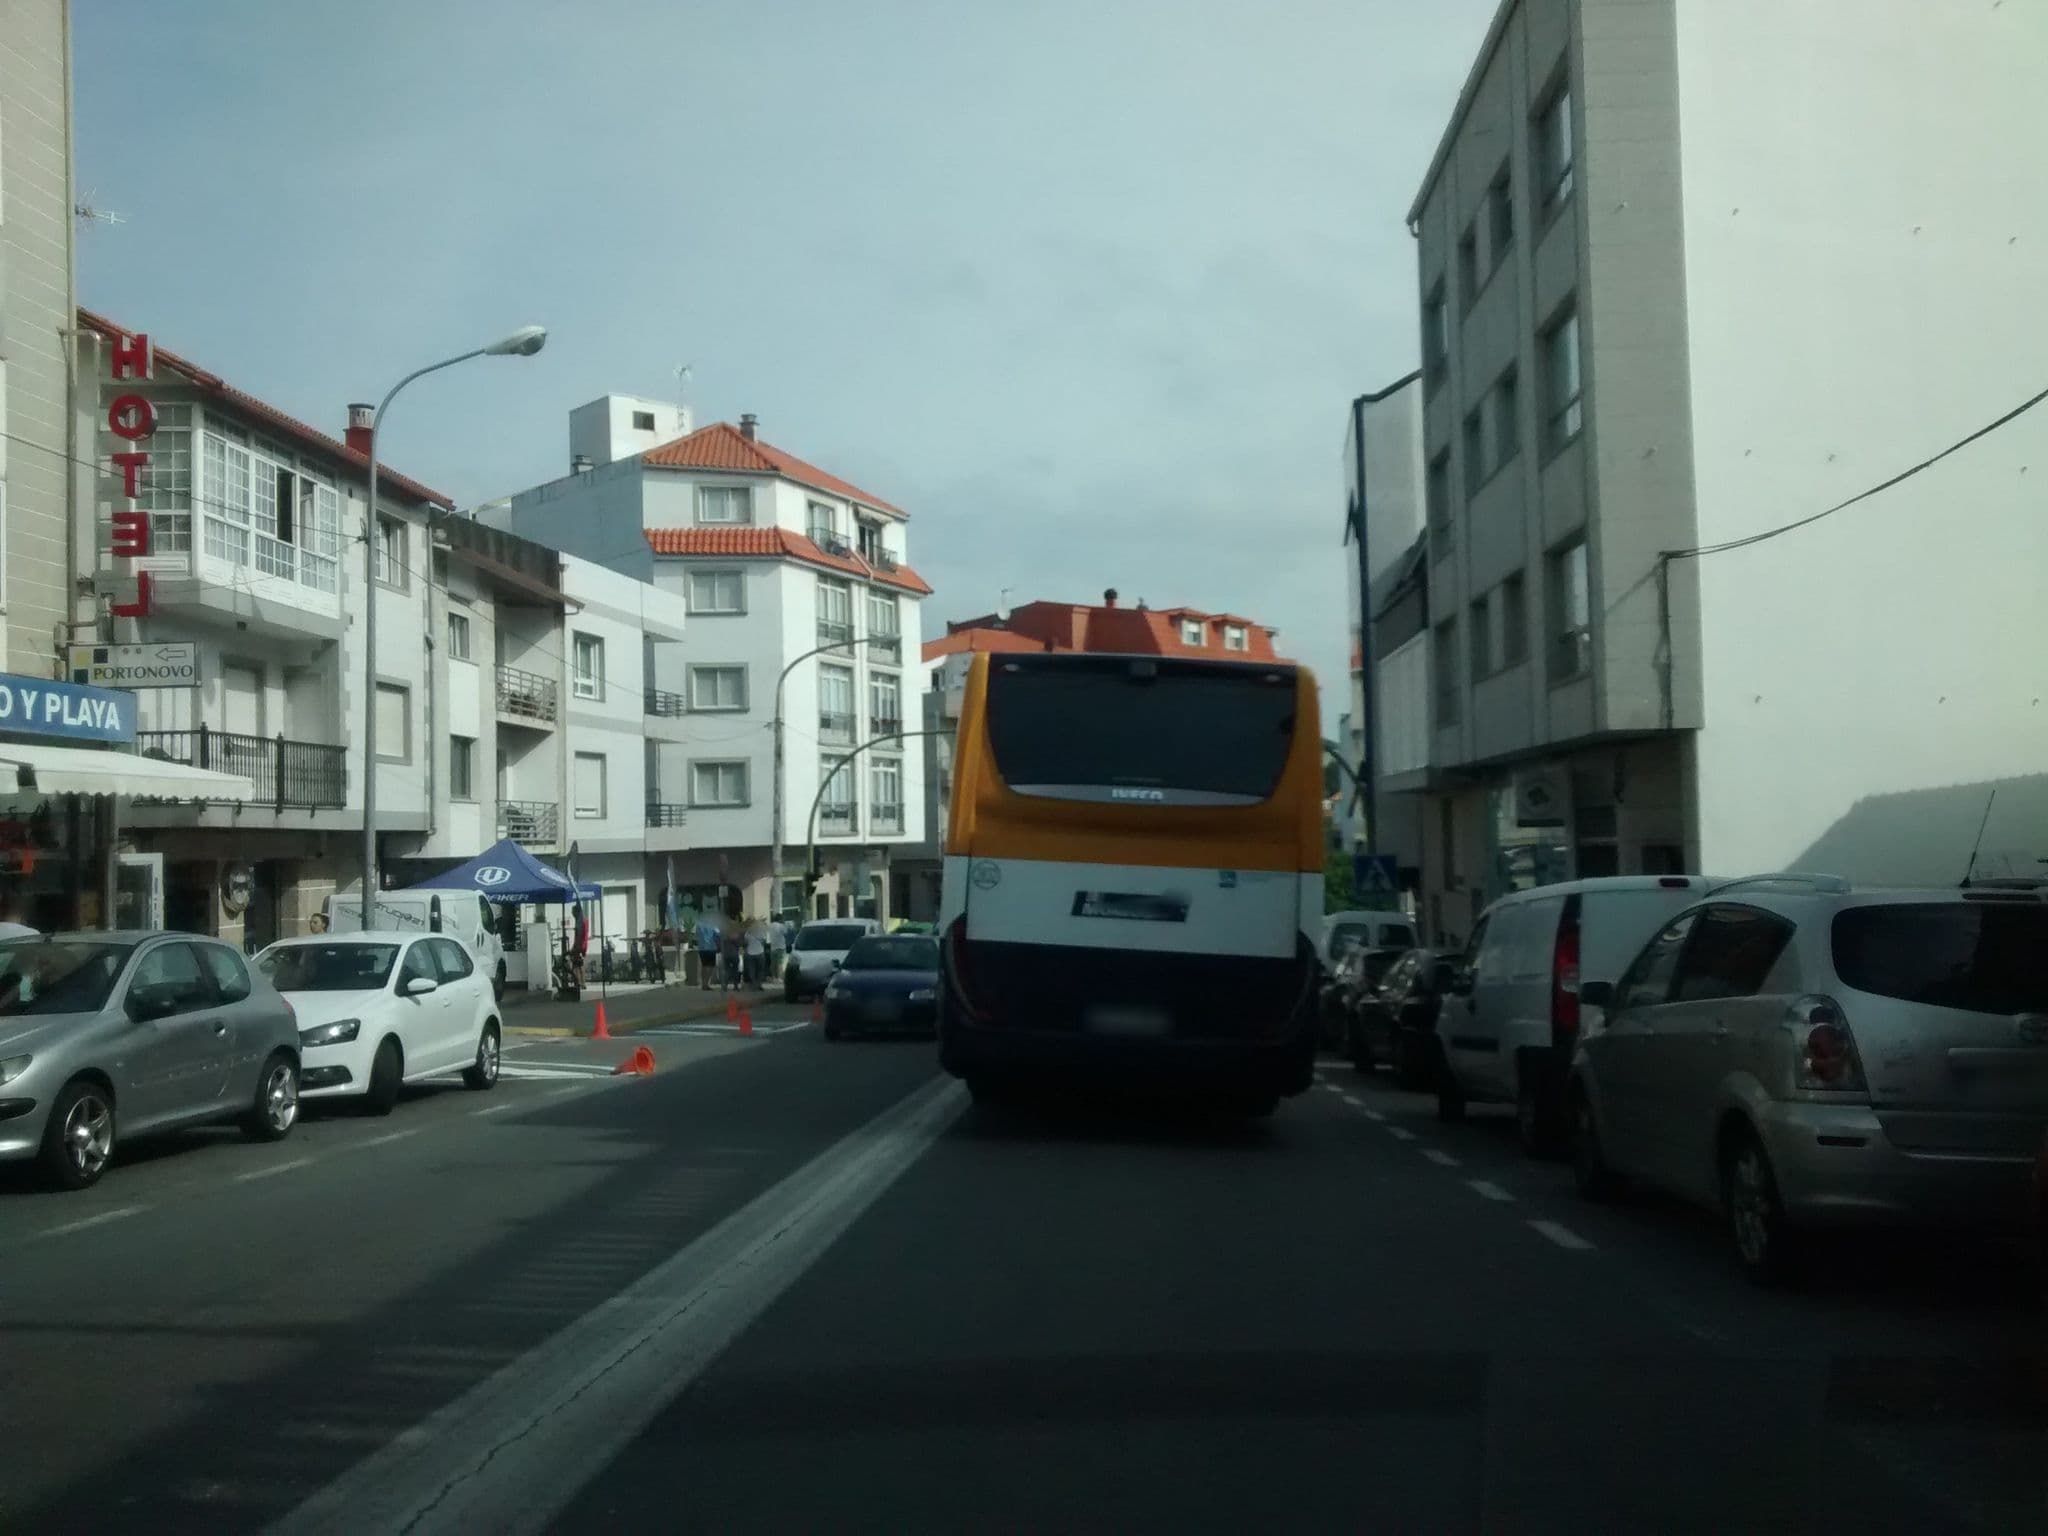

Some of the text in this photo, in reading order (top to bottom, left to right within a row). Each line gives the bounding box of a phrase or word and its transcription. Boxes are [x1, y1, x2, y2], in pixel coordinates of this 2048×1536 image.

[93, 665, 193, 680] PORTONOVO
[20, 689, 38, 720] Y
[45, 692, 121, 731] PLAYA
